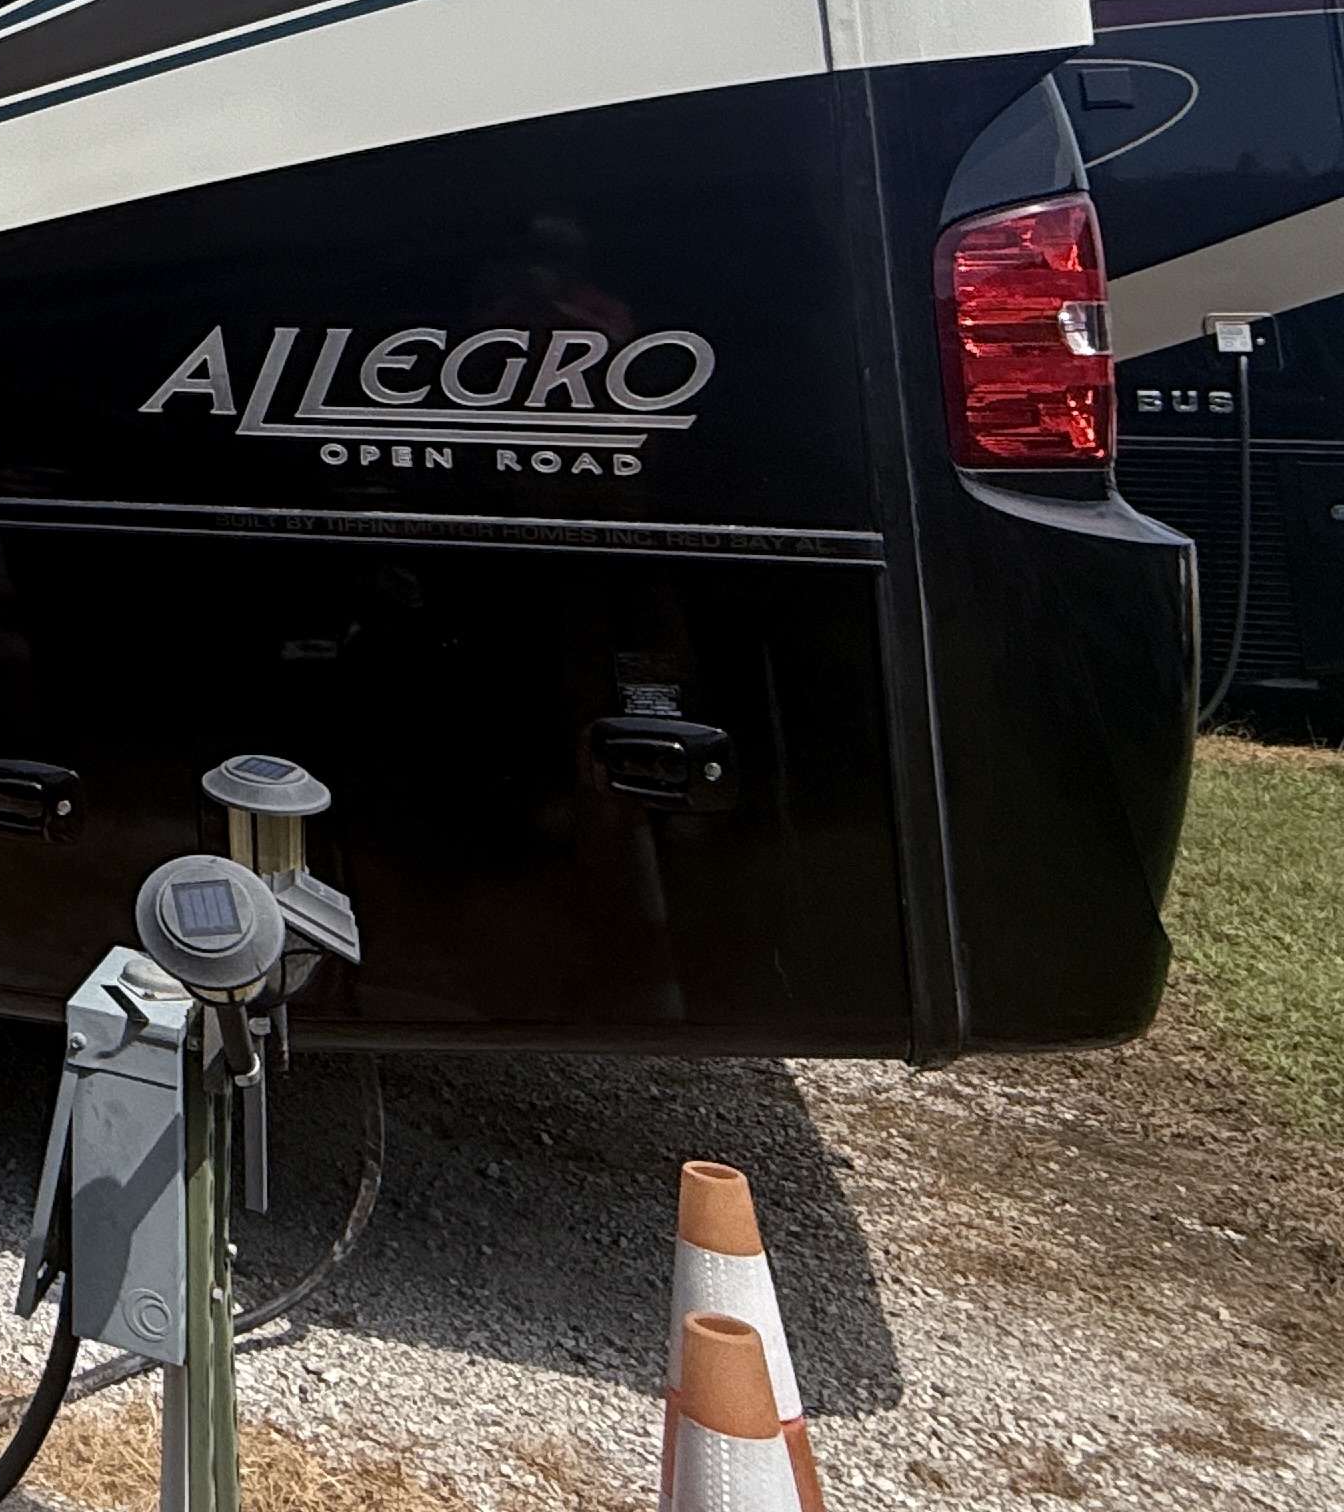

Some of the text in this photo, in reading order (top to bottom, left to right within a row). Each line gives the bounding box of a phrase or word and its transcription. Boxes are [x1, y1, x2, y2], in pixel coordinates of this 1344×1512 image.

[138, 325, 716, 448] ALLEGRO
[1135, 389, 1235, 414] BUS
[320, 443, 643, 476] OPEN ROAD
[215, 513, 278, 528] BUILT
[286, 515, 315, 531] BY
[322, 517, 394, 534] TIFFIN
[403, 521, 494, 538] MOTOR
[502, 524, 597, 543] HOMES
[666, 531, 721, 547] RED
[730, 533, 785, 550] BAY
